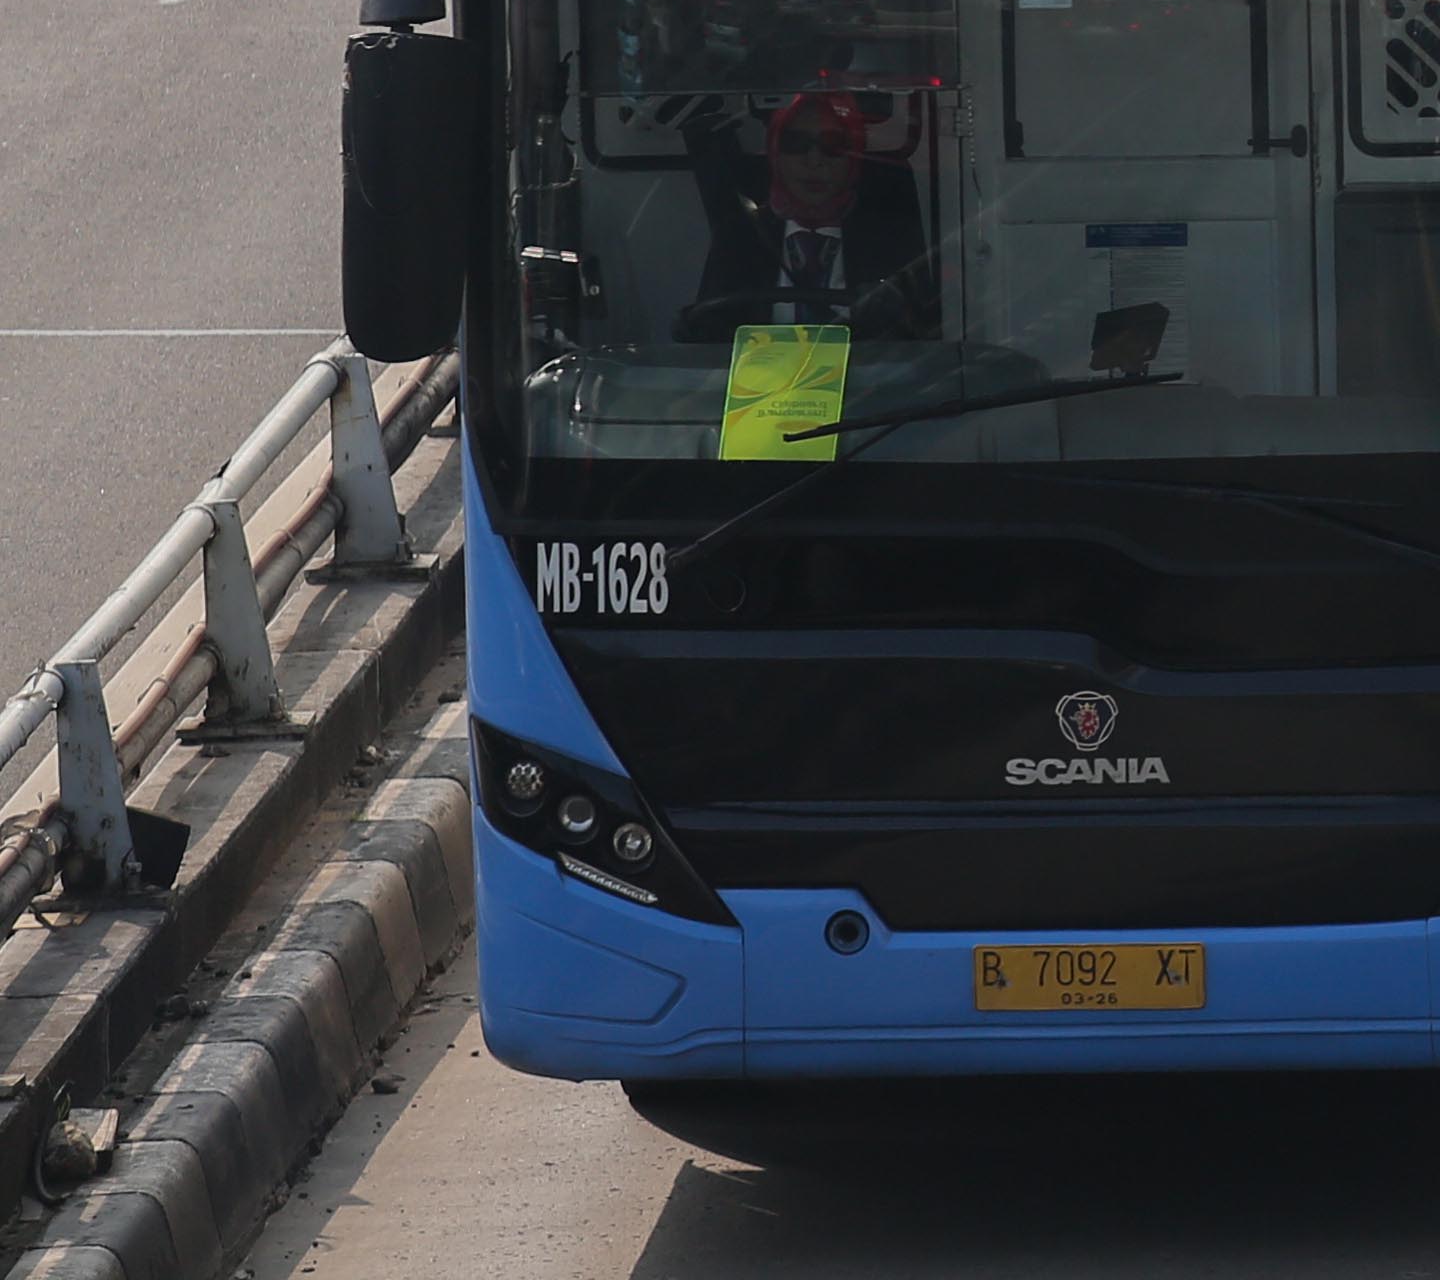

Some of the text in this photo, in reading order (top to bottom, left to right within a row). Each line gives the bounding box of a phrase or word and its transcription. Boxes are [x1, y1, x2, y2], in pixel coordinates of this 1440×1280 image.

[537, 542, 670, 615] MB-1628
[1004, 755, 1173, 786] SCANIA
[982, 949, 1197, 987] B 7092 XT
[1061, 992, 1118, 1005] 03-26
